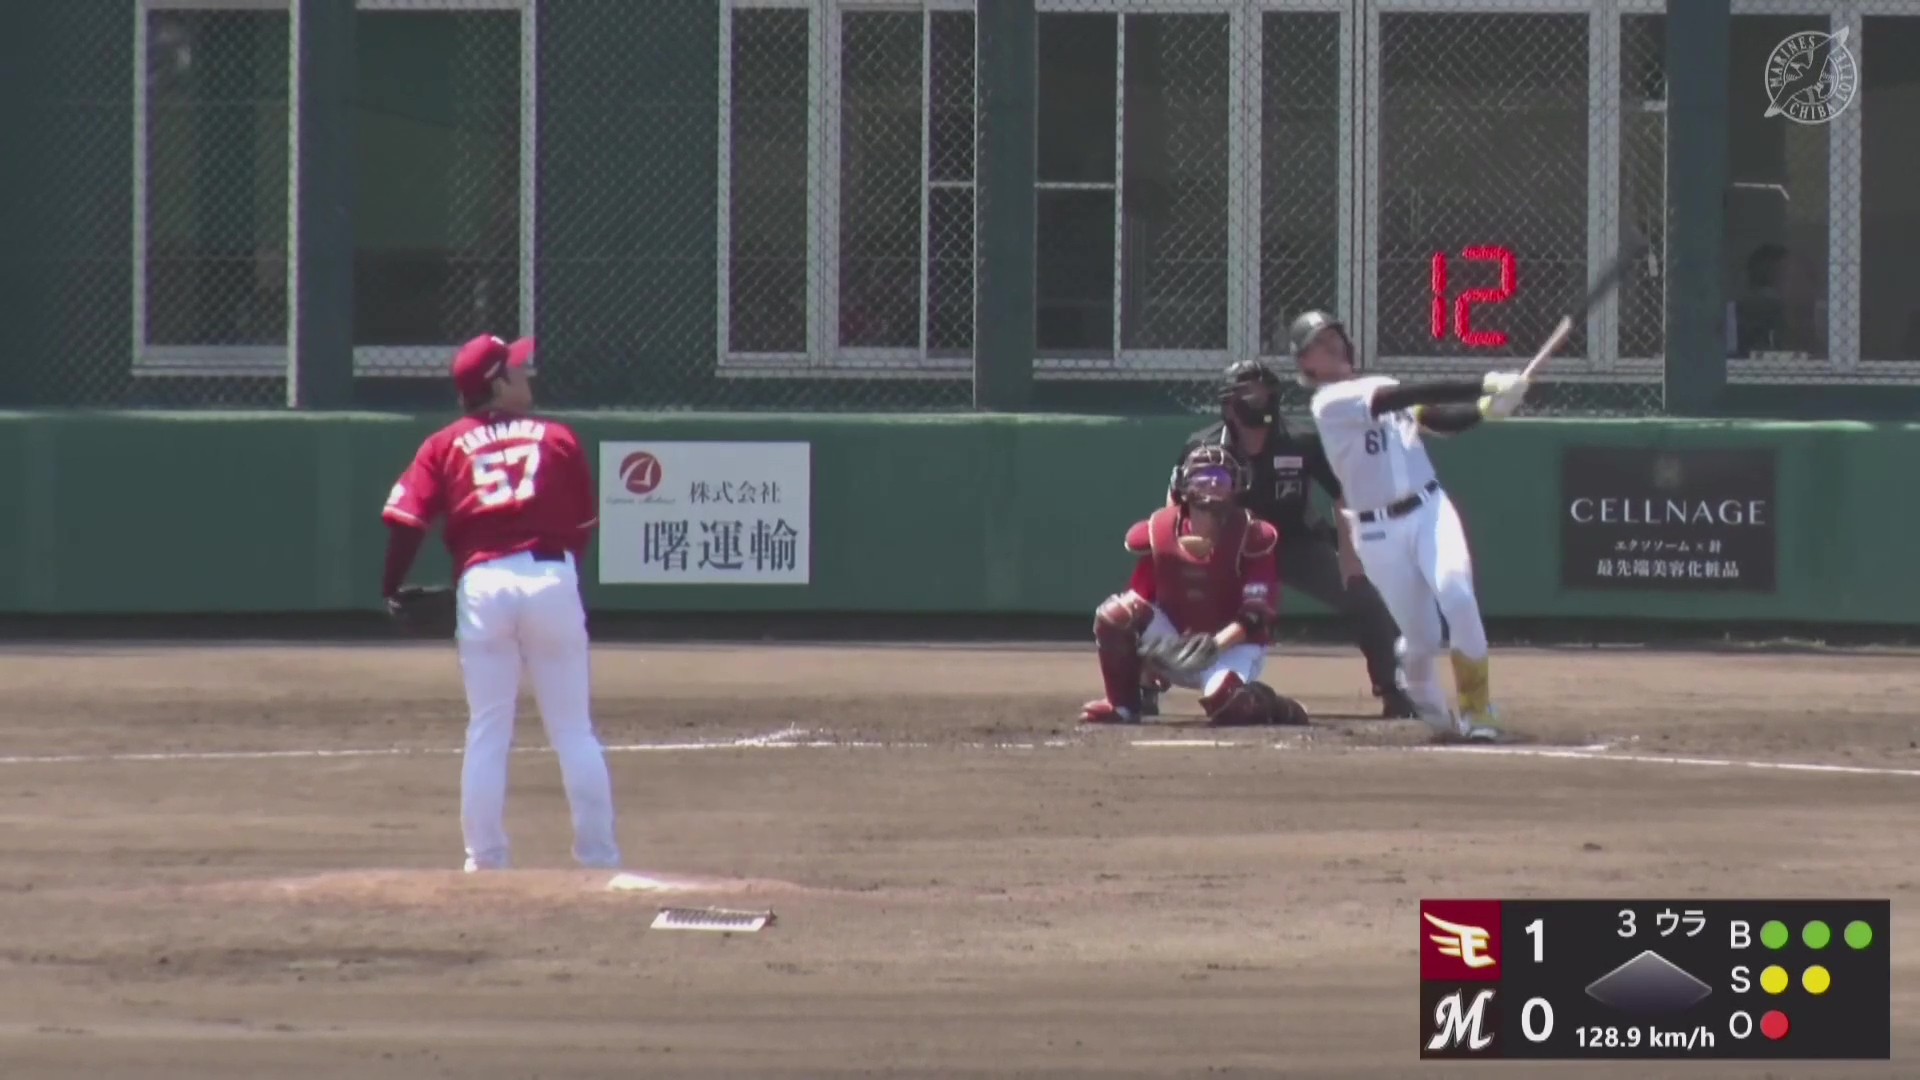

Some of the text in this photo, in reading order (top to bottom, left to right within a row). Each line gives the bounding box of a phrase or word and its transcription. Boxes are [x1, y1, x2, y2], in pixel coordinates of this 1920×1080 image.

[1431, 246, 1517, 347] 12
[1365, 428, 1388, 455] 61
[473, 443, 540, 505] 57
[689, 480, 781, 505] 株式会社
[1570, 498, 1766, 525] CELLNAGE
[643, 518, 798, 572] 曙運輸
[1597, 559, 1740, 579] 最先端美容化粧品
